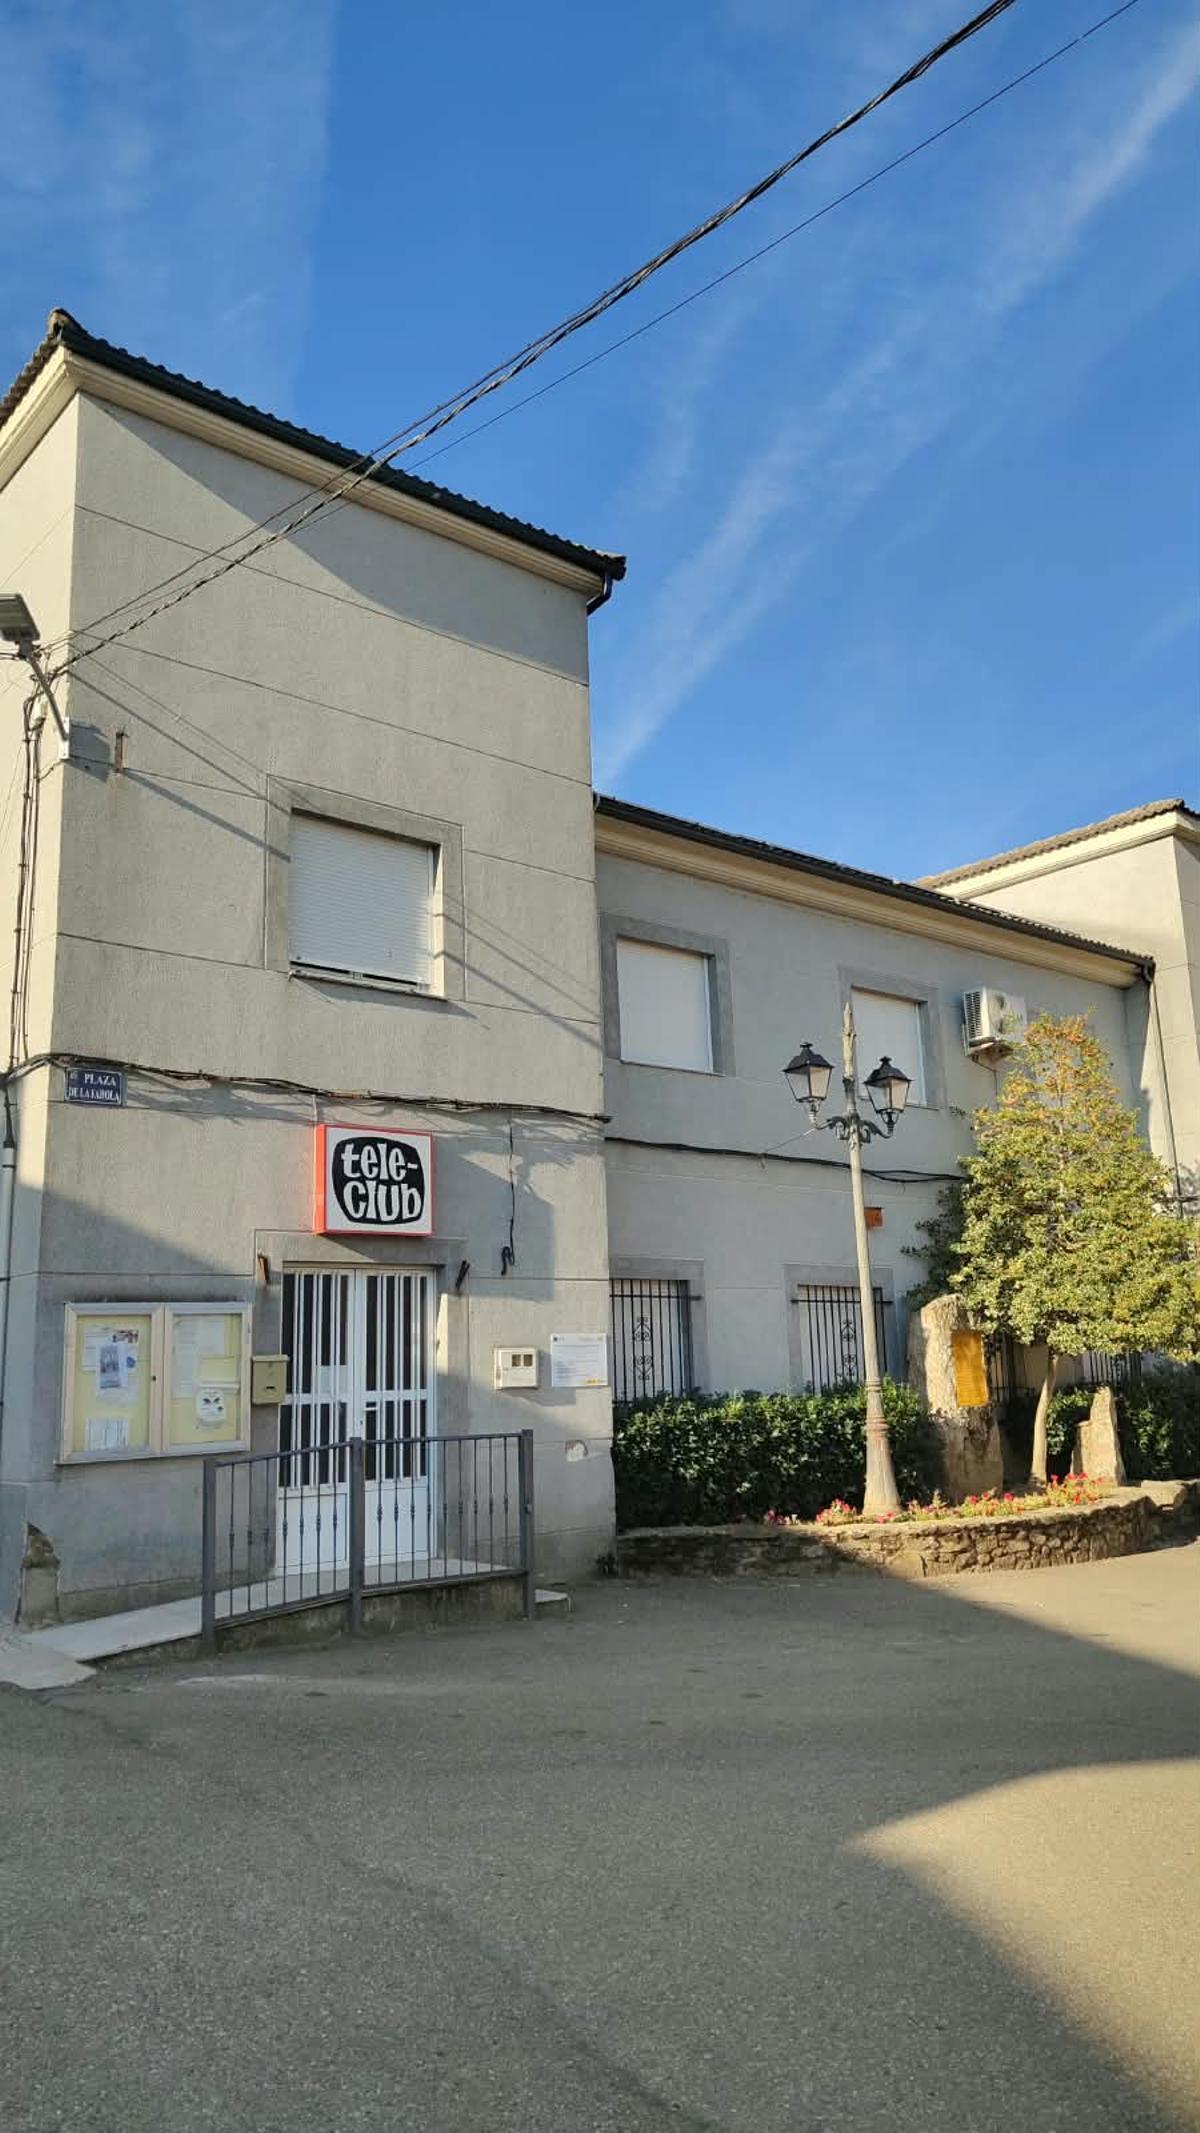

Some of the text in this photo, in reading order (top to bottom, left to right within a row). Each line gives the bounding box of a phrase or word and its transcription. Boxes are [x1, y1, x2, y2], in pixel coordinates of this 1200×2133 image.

[84, 1073, 116, 1087] PLAZA
[69, 1087, 79, 1097] DE
[80, 1088, 90, 1099] LA
[341, 1143, 418, 1181] tele-
